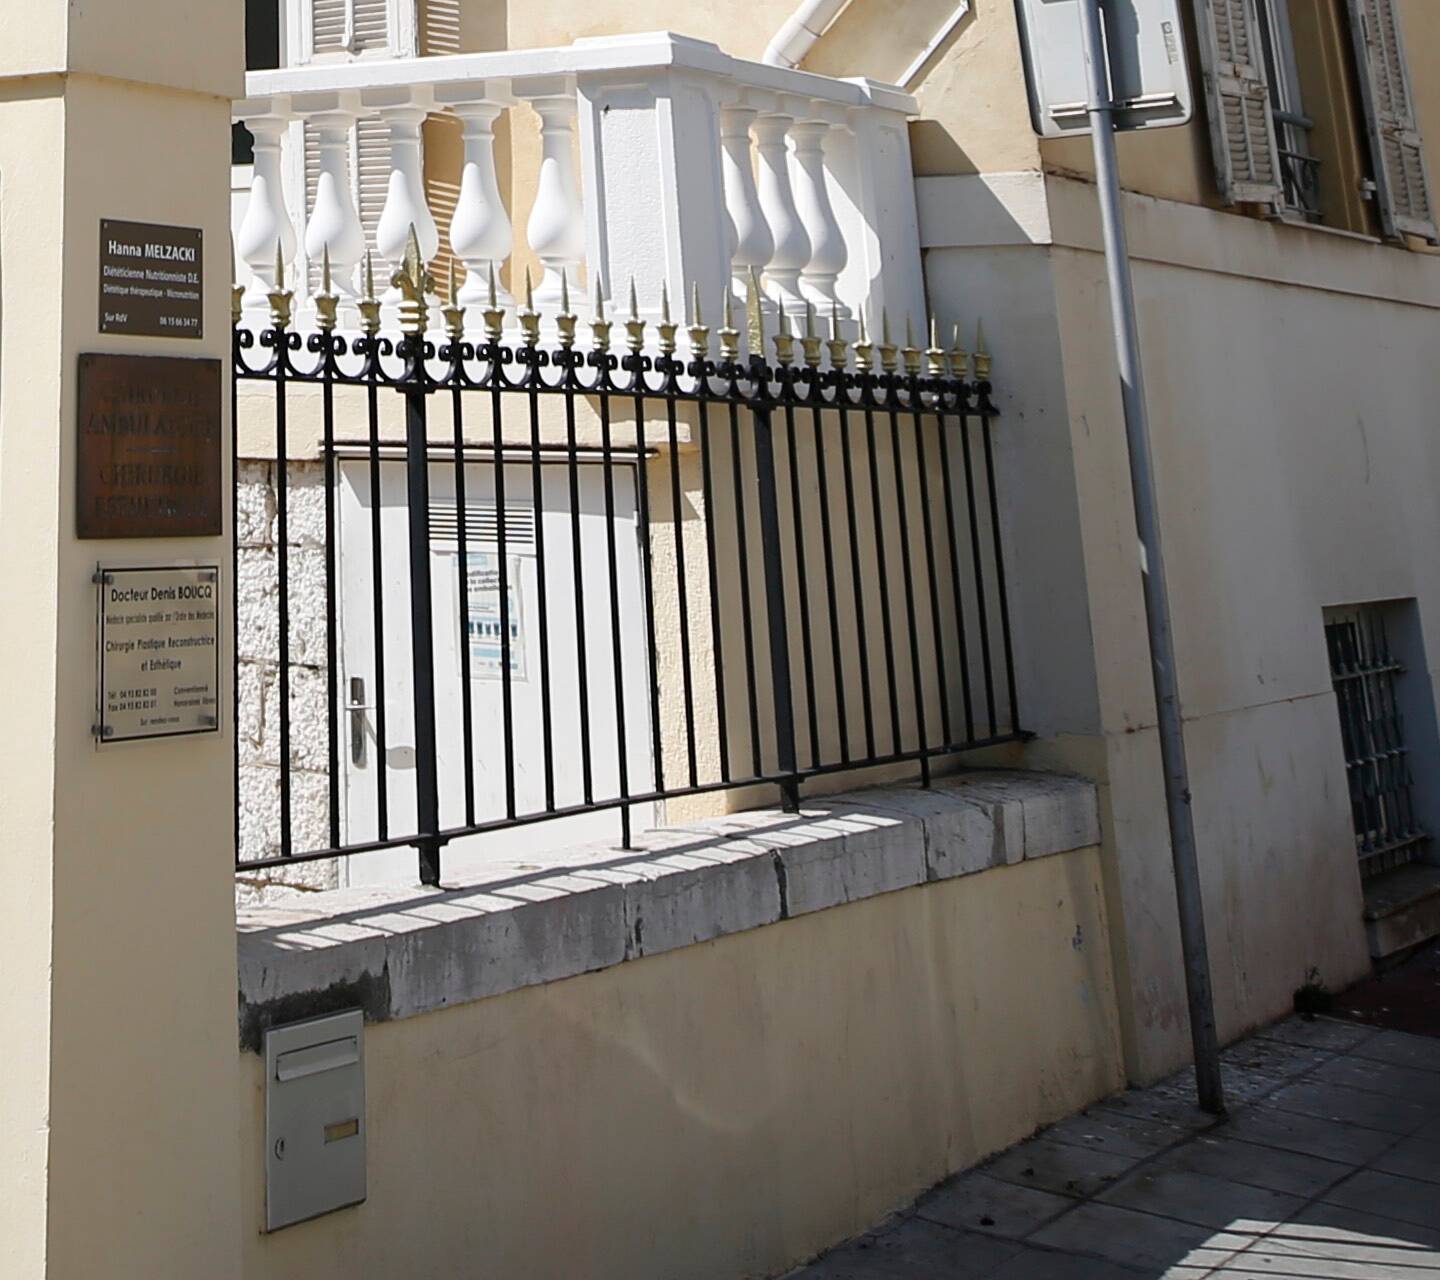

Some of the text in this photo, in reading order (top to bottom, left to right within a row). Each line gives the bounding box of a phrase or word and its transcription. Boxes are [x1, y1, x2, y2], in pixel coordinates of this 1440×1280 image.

[108, 240, 195, 262] Hanna MELZACKI
[111, 585, 212, 602] Docteur Denis BOUCQ
[105, 640, 135, 653] Chirurgie
[137, 638, 165, 649] Plastique
[141, 660, 148, 672] et
